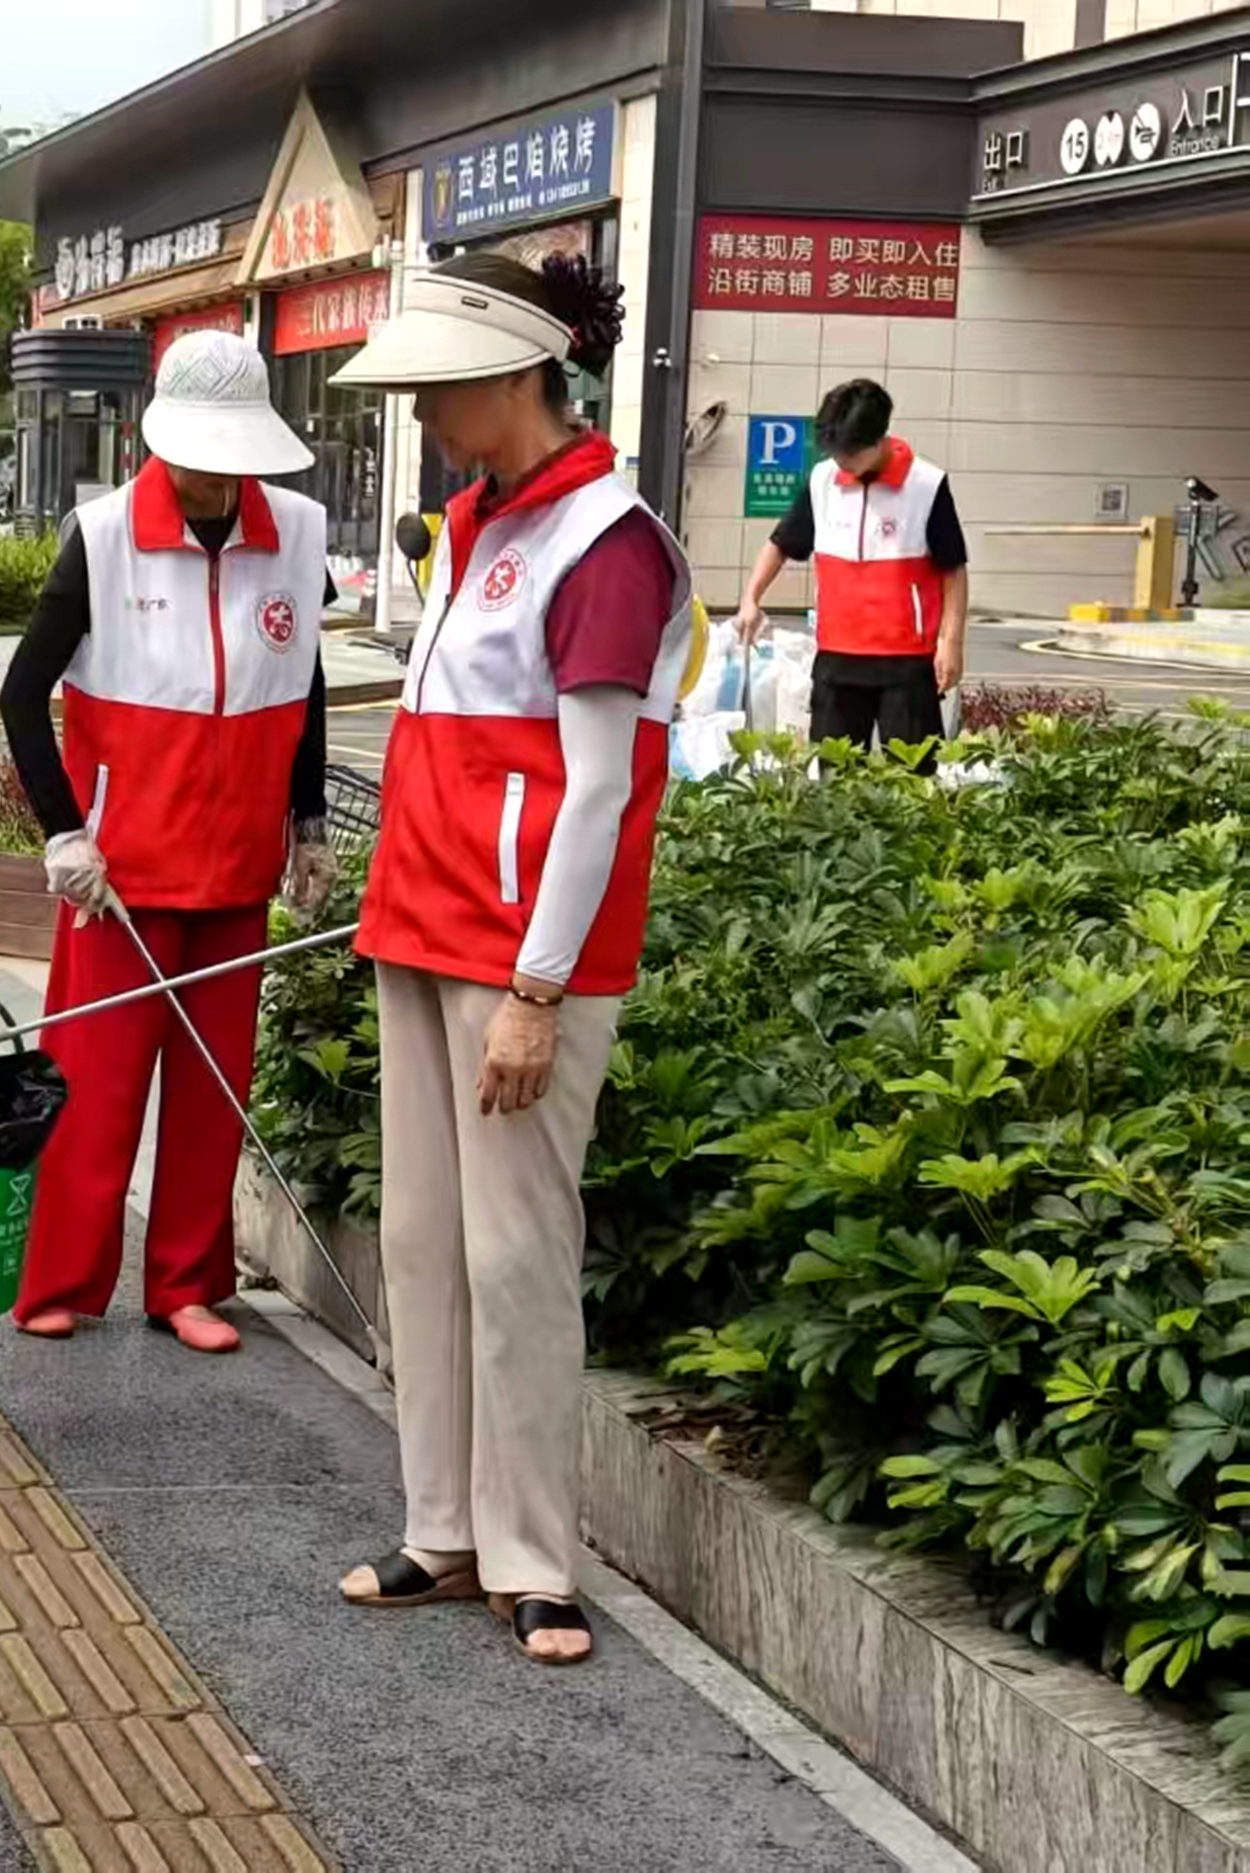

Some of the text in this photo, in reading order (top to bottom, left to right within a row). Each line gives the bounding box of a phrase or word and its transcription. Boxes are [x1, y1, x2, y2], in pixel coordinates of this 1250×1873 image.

[1171, 87, 1224, 133] 入口
[983, 131, 1023, 170] 出口
[1065, 131, 1086, 160] 15
[709, 232, 959, 268] 精装现房 即买即入住
[707, 267, 957, 302] 沿街商铺 多业态租售
[759, 422, 796, 464] P
